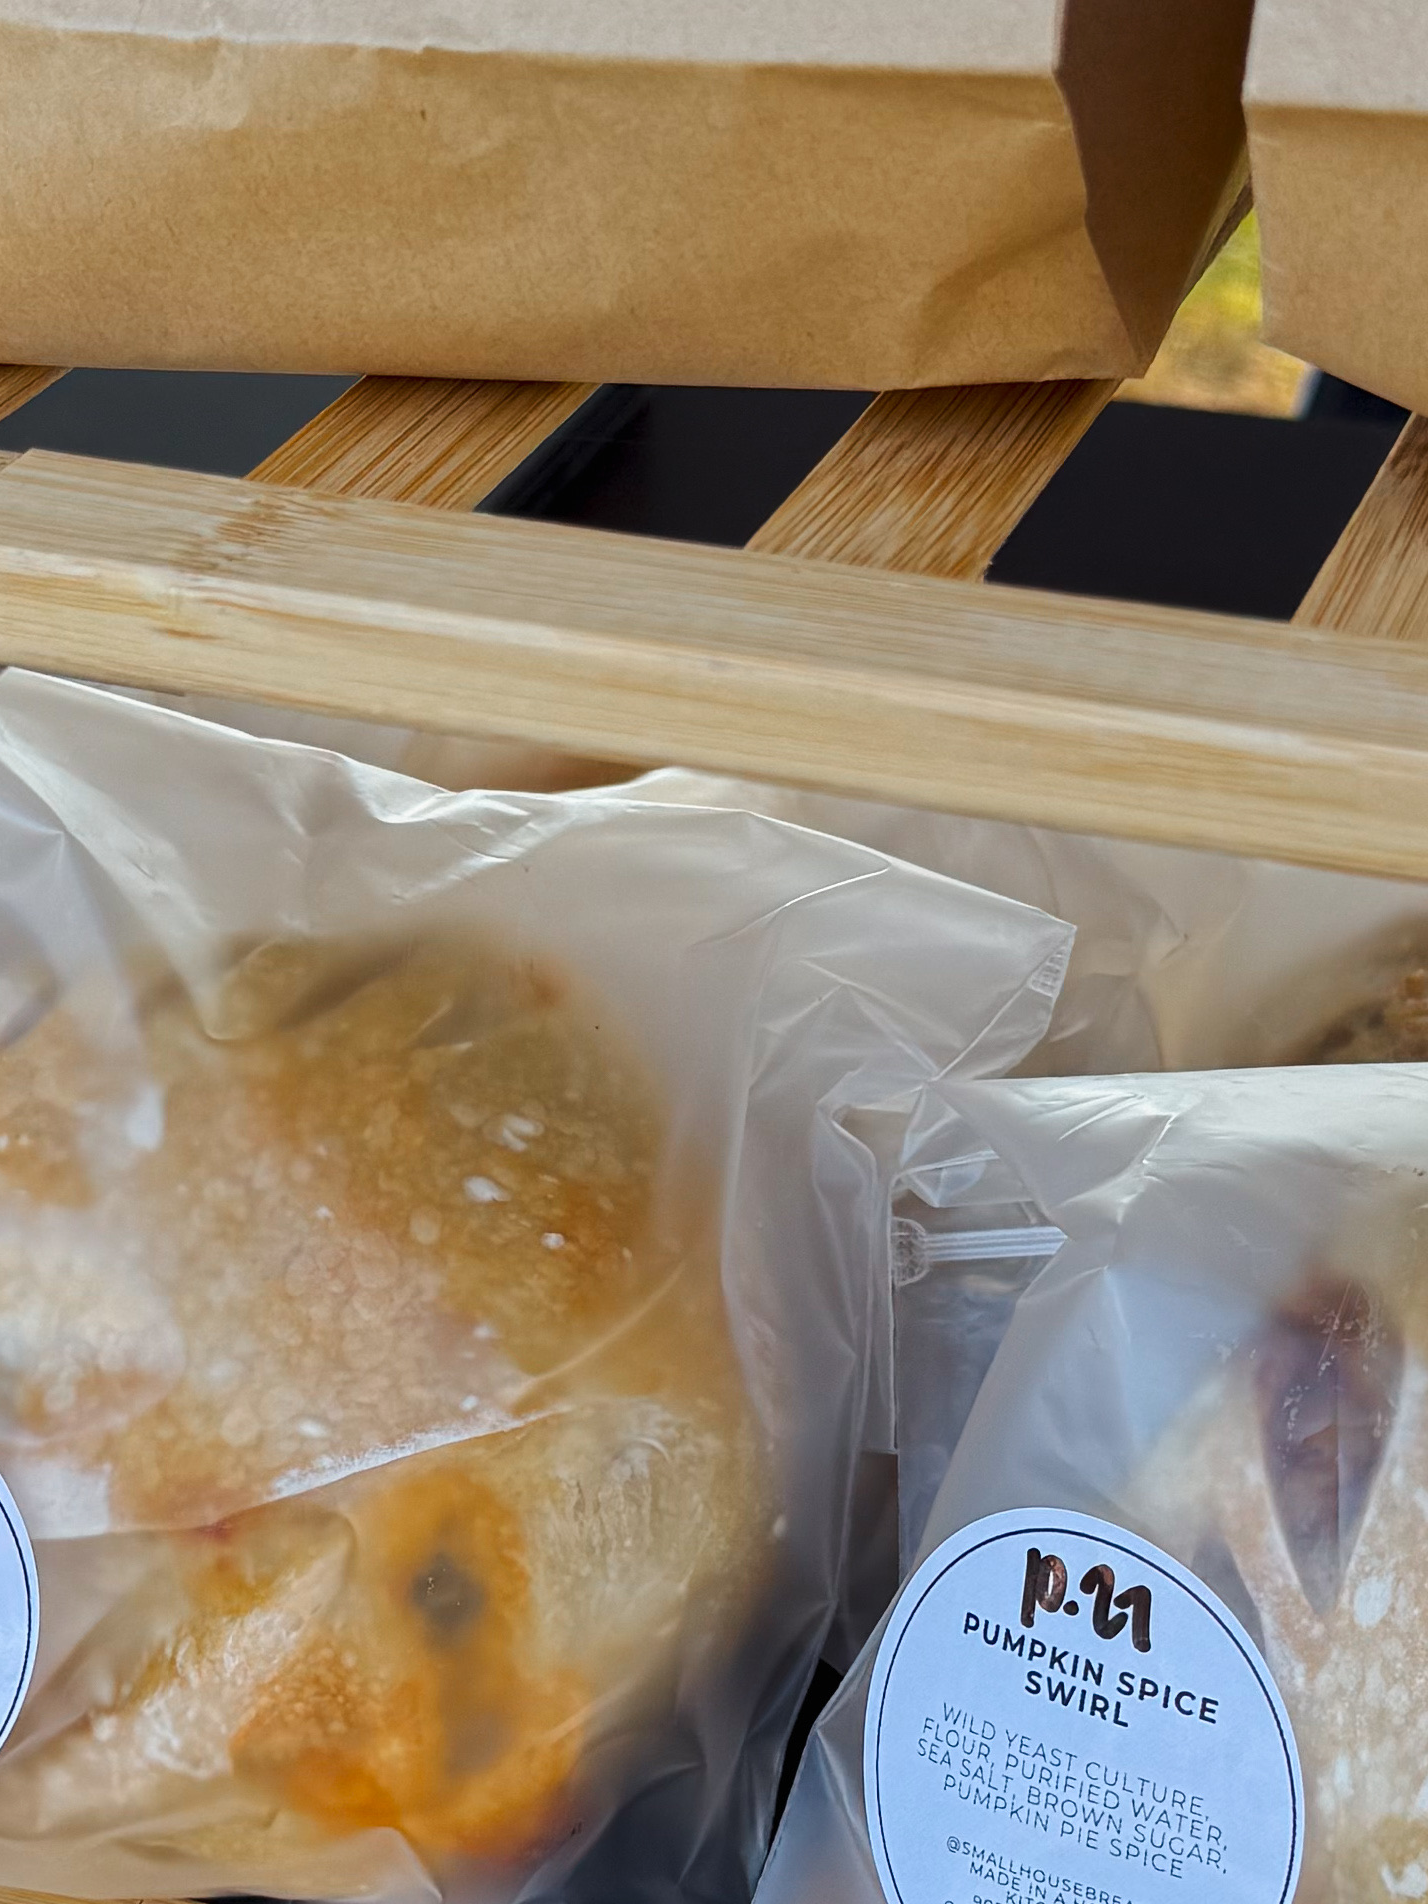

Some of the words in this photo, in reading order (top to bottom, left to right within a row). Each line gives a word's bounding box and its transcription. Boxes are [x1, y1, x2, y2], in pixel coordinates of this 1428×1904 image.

[963, 1613, 1103, 1686] PUMPKIN
[1117, 1672, 1219, 1724] SPICE
[1025, 1671, 1128, 1727] SWIRL
[917, 1739, 952, 1768] SEA
[960, 1760, 1015, 1801] SALT,
[1028, 1787, 1122, 1834] BROWN
[1134, 1824, 1227, 1874] SUGAR,
[924, 1718, 994, 1767] FLOUR,
[1006, 1754, 1120, 1810] PURIFIED
[1132, 1799, 1227, 1851] WATER,
[943, 1702, 996, 1740] WILD
[1006, 1730, 1077, 1772] YEAST
[1086, 1762, 1209, 1821] CULTURE,
[944, 1775, 1049, 1832] PUMPKIN
[1061, 1821, 1099, 1850] PIE
[1110, 1839, 1183, 1879] SPICE
[970, 1862, 1021, 1891] MADE
[1029, 1883, 1046, 1899] IN
